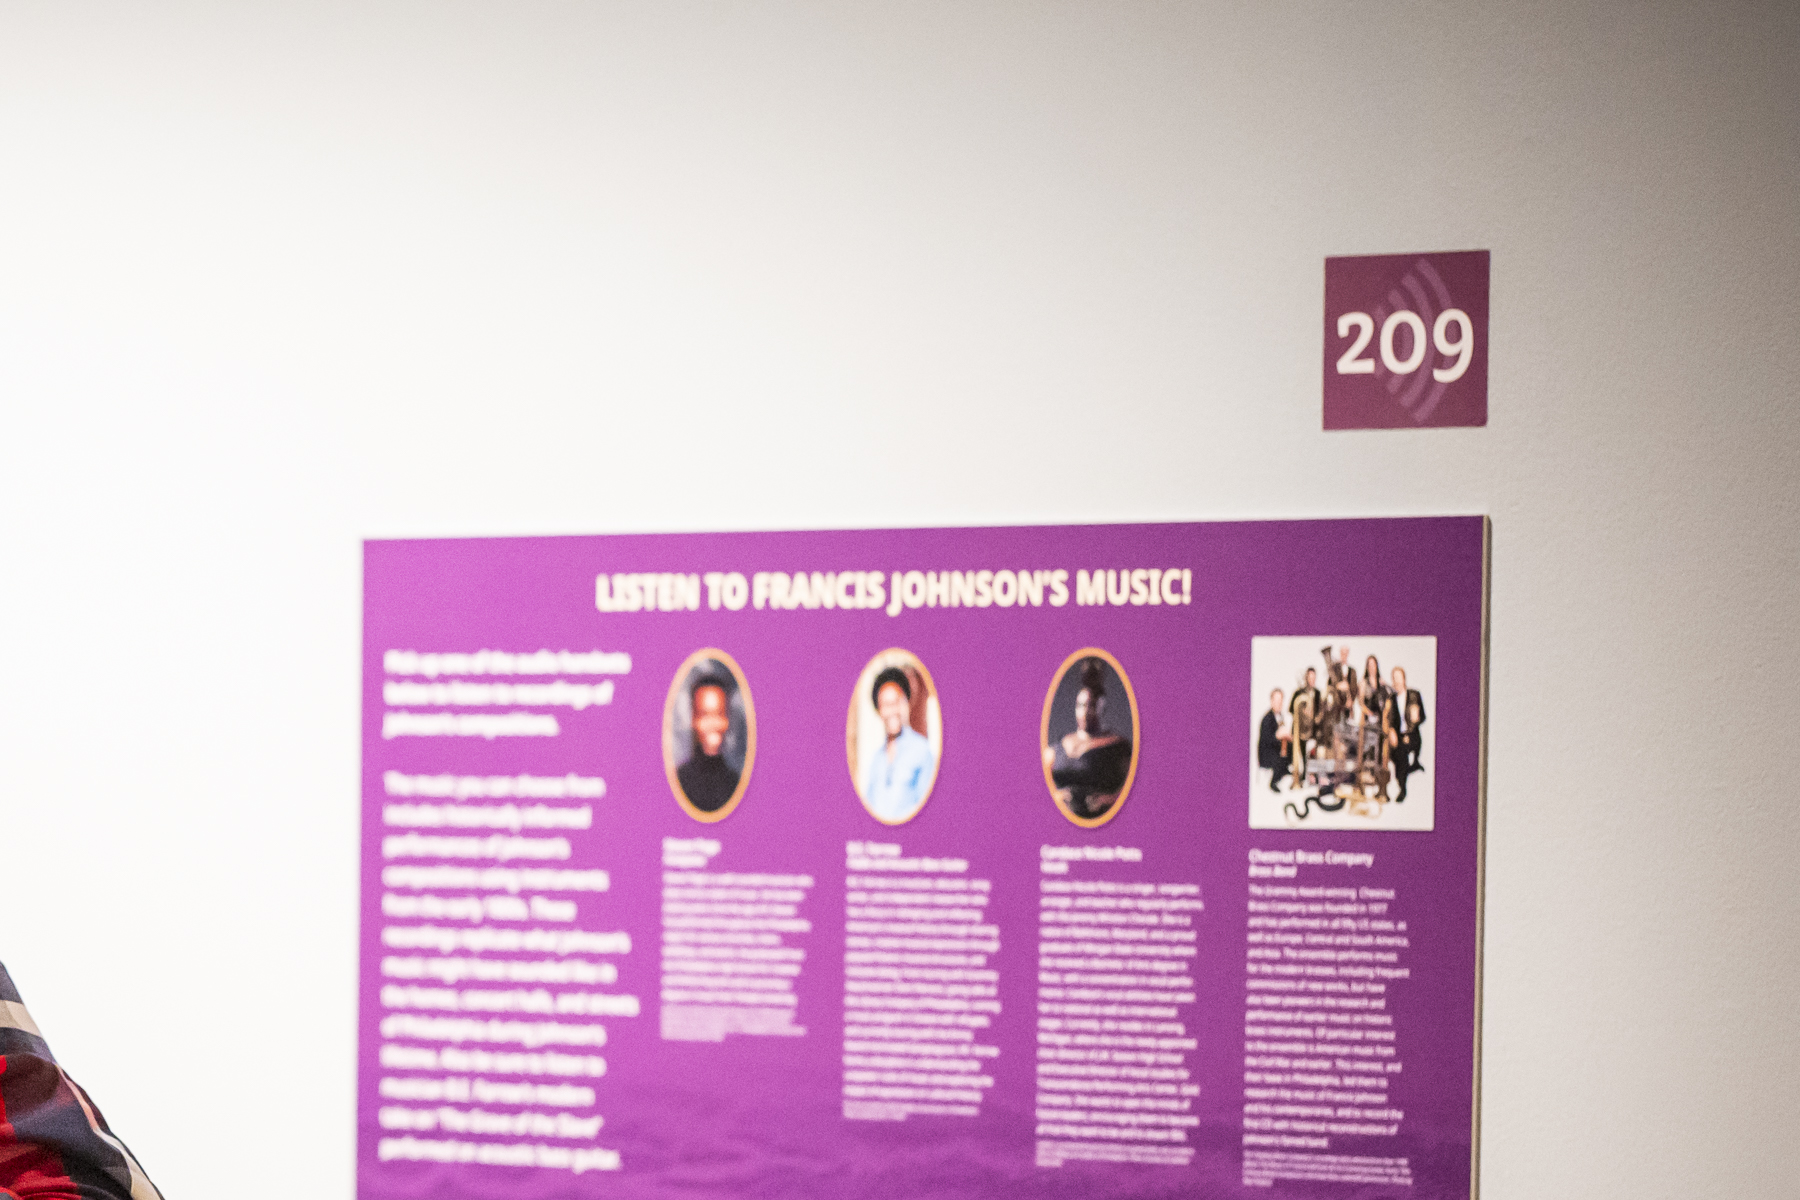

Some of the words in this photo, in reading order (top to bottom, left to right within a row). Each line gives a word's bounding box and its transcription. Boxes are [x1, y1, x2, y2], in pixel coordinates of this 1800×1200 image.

[1336, 308, 1474, 383] 209
[595, 571, 701, 612] LISTEN
[703, 571, 749, 611] TO
[752, 570, 886, 611] FRANCIS
[886, 569, 1070, 617] JOHNSON'S
[1075, 567, 1193, 608] MUSIC!
